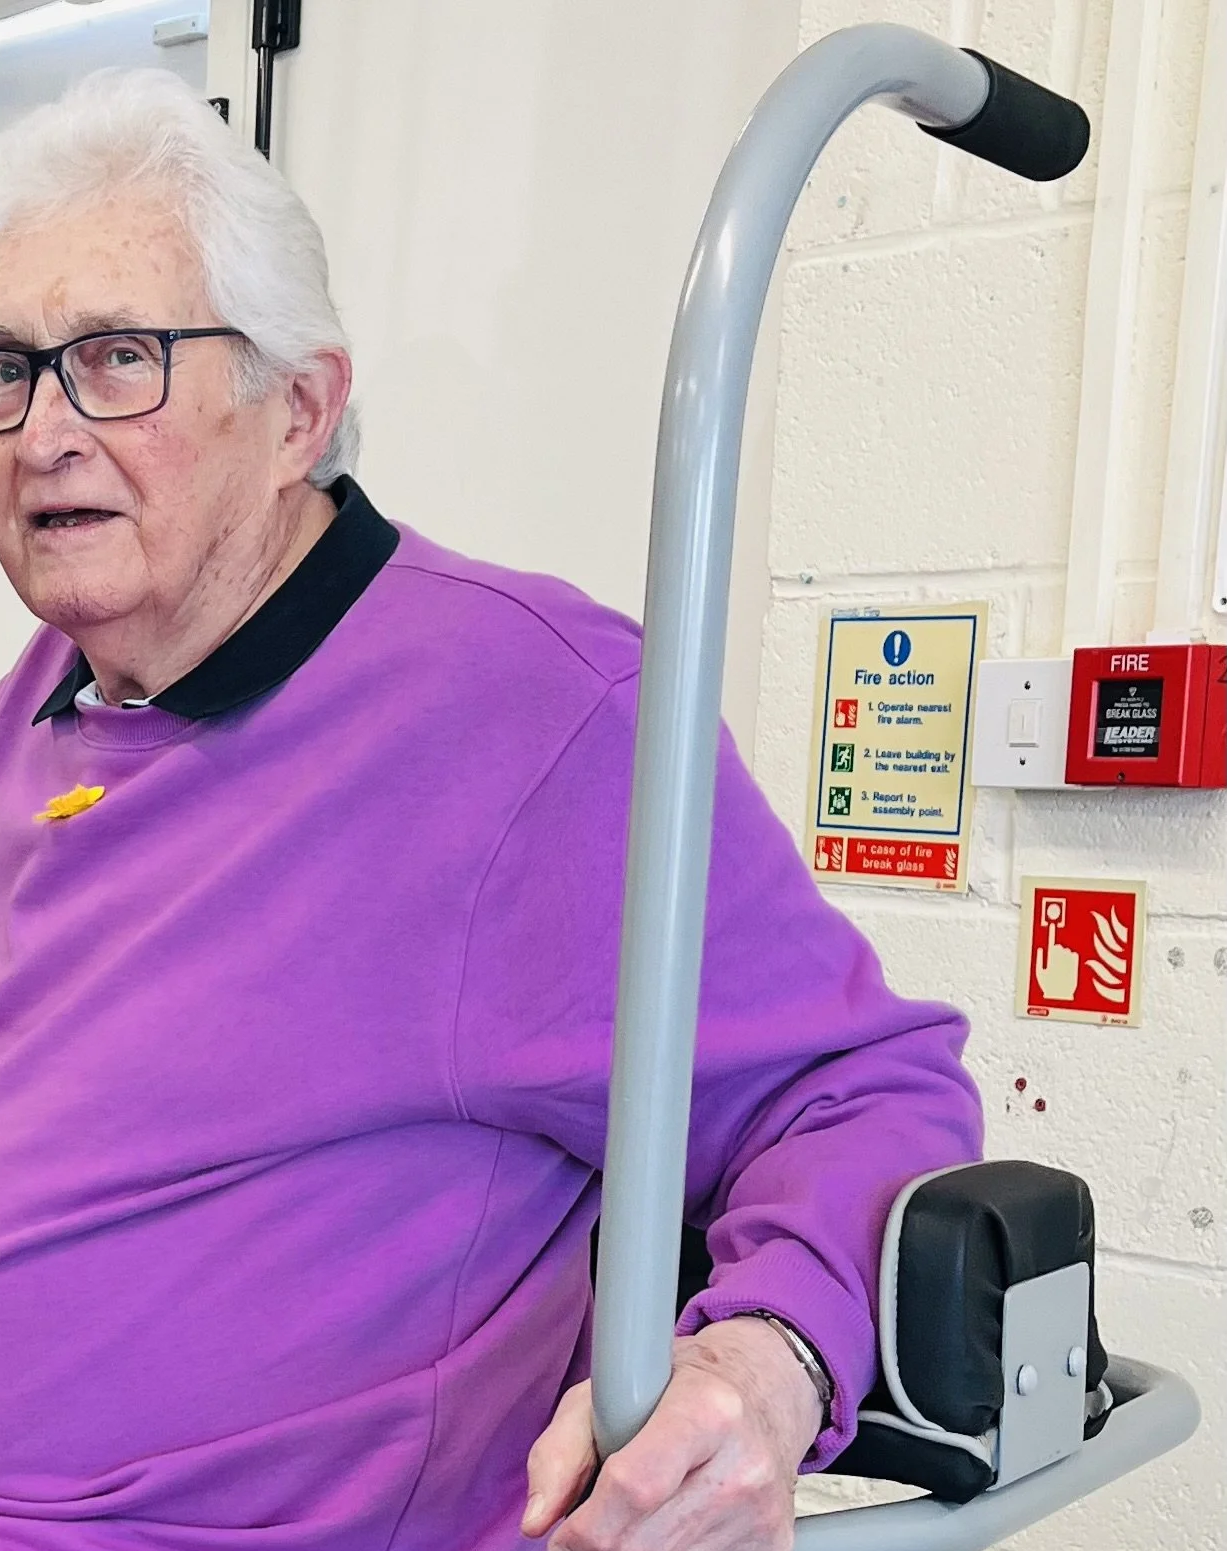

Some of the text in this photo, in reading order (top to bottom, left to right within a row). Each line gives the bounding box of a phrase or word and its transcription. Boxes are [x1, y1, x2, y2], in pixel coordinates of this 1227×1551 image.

[1111, 654, 1150, 671] FIRE
[855, 670, 934, 685] Fire action
[878, 702, 913, 713] Operate
[918, 703, 951, 712] nearest
[1106, 708, 1157, 719] BREAK GLASS
[878, 715, 923, 725] fire alarm.
[1104, 726, 1156, 744] LEADER
[864, 749, 955, 762] 2. Leave building by
[875, 762, 950, 773] the nearest exit.
[861, 792, 916, 803] 3. Report to
[873, 805, 916, 818] assembly
[857, 842, 933, 857] In case of fire
[863, 858, 924, 873] break glass
